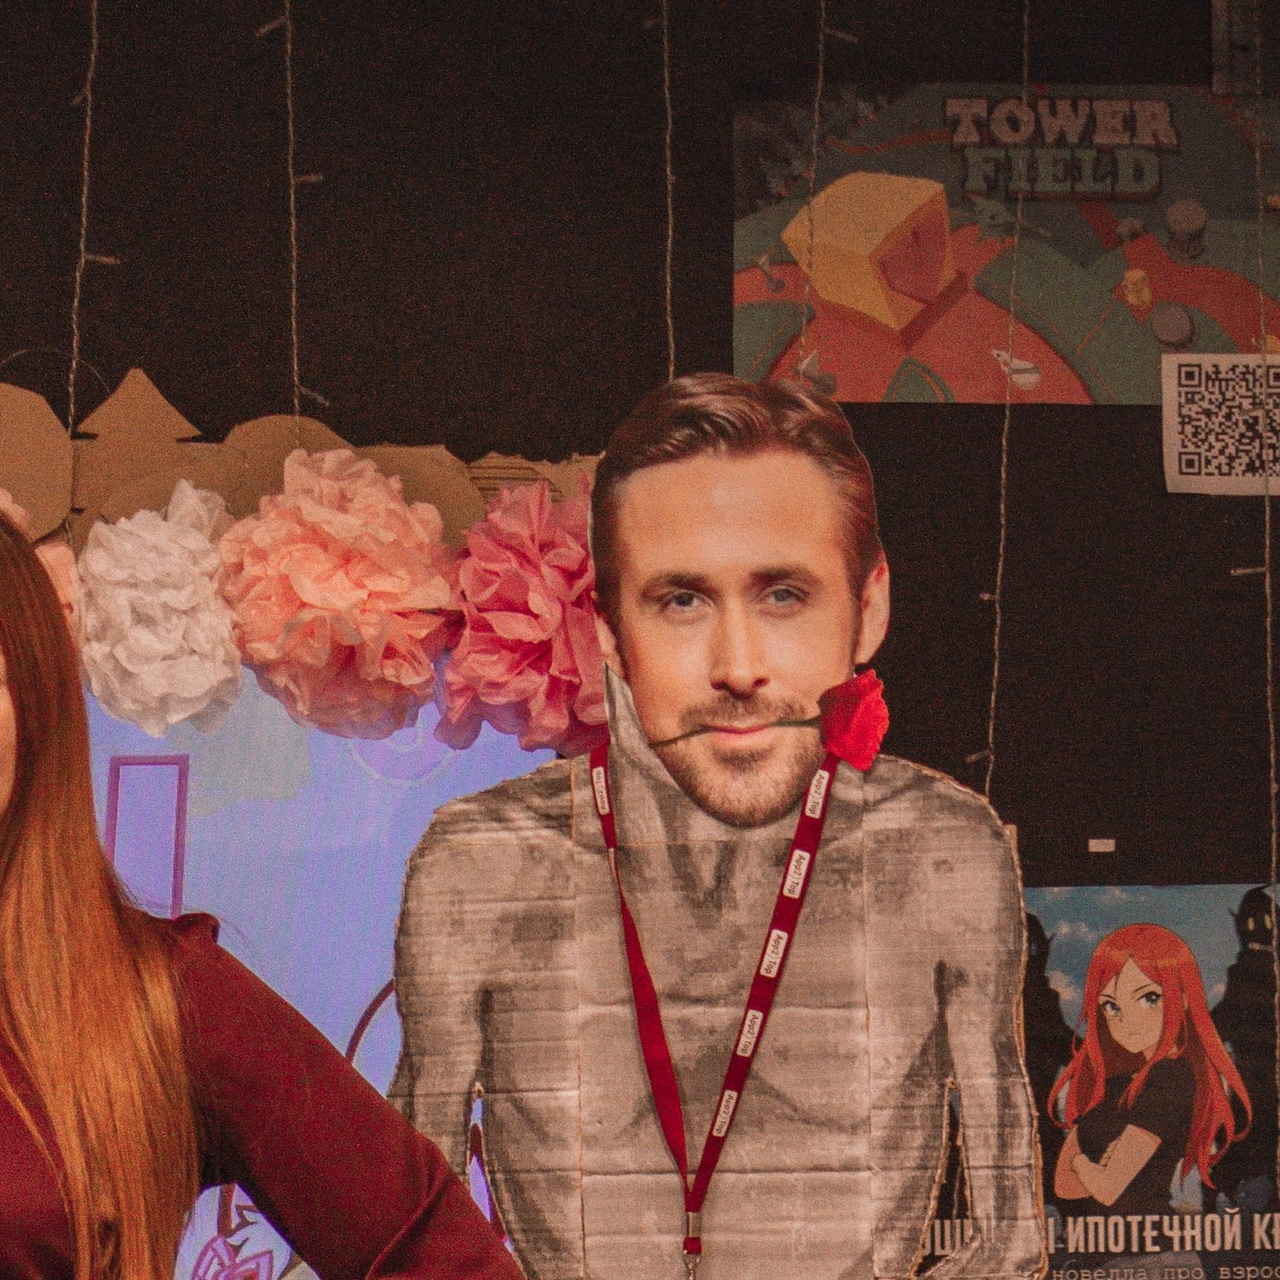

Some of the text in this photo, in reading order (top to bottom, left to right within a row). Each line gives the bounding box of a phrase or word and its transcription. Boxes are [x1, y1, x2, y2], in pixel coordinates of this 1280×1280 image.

[944, 97, 1179, 149] TOWER
[963, 146, 1163, 198] FIELD
[1067, 1206, 1242, 1254] ИПОТЕЧНОЙ
